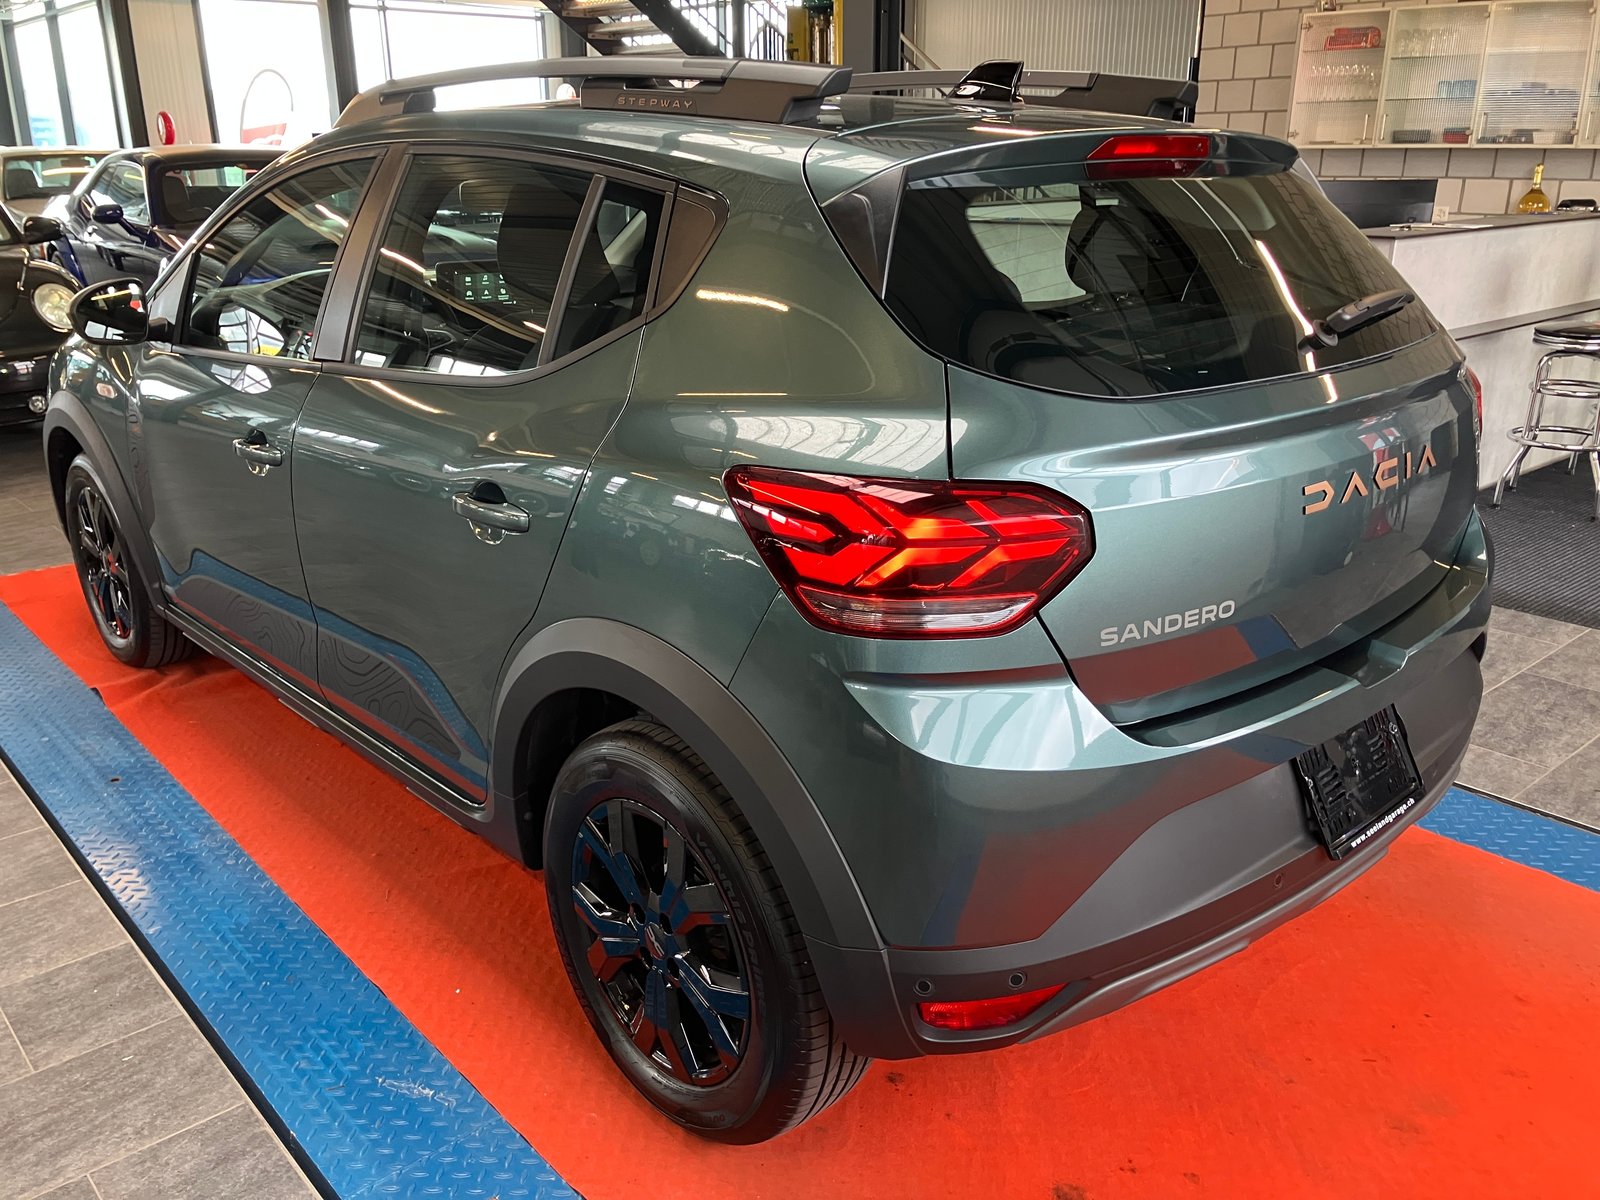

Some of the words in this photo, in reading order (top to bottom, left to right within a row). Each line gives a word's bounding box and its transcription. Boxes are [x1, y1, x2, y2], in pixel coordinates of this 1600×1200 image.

[617, 96, 692, 109] STEPWAY
[1302, 444, 1437, 515] DACIA
[1100, 599, 1236, 647] SANDERO
[1350, 797, 1416, 848] www.seelandgarage.ch
